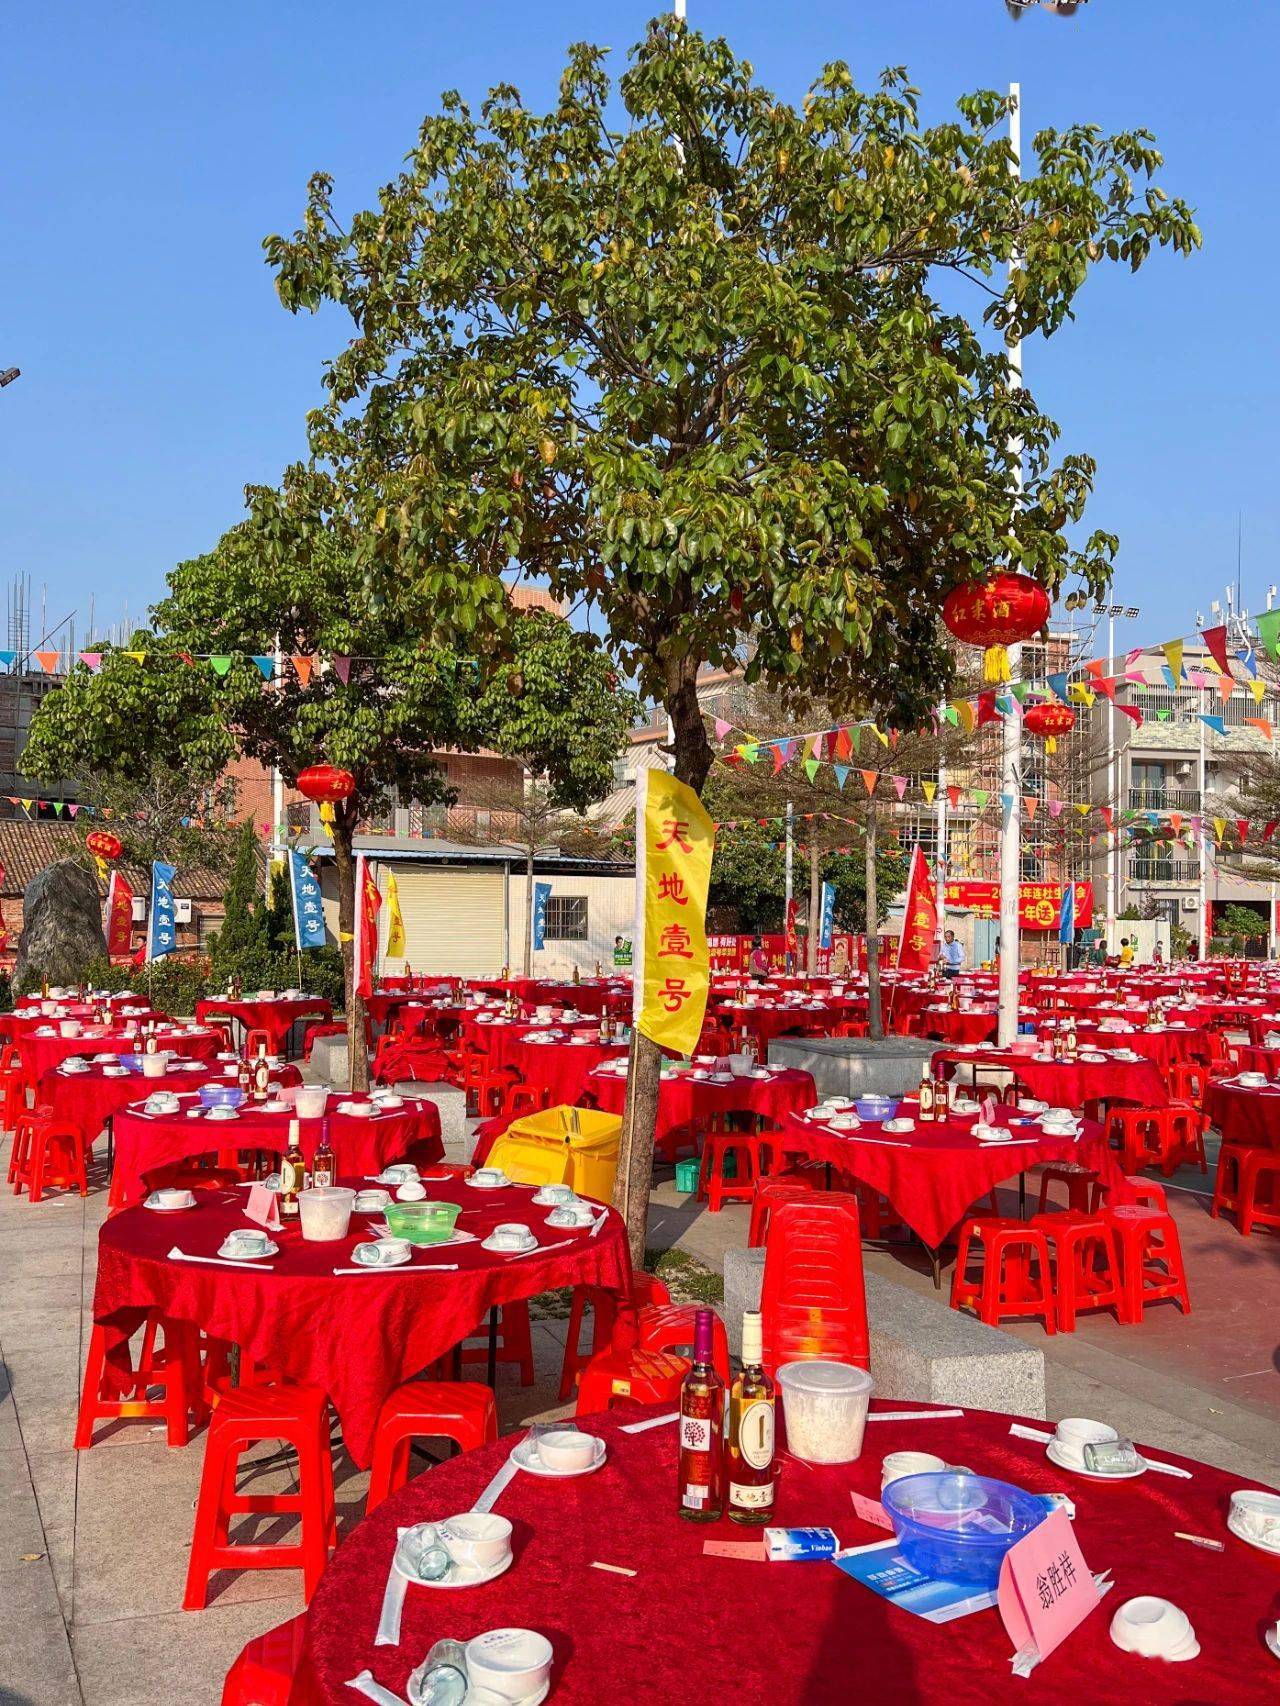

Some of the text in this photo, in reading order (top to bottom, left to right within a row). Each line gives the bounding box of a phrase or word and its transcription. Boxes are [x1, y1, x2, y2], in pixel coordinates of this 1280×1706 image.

[300, 865, 320, 933] 天地壹号
[656, 820, 694, 1013] 天地壹号
